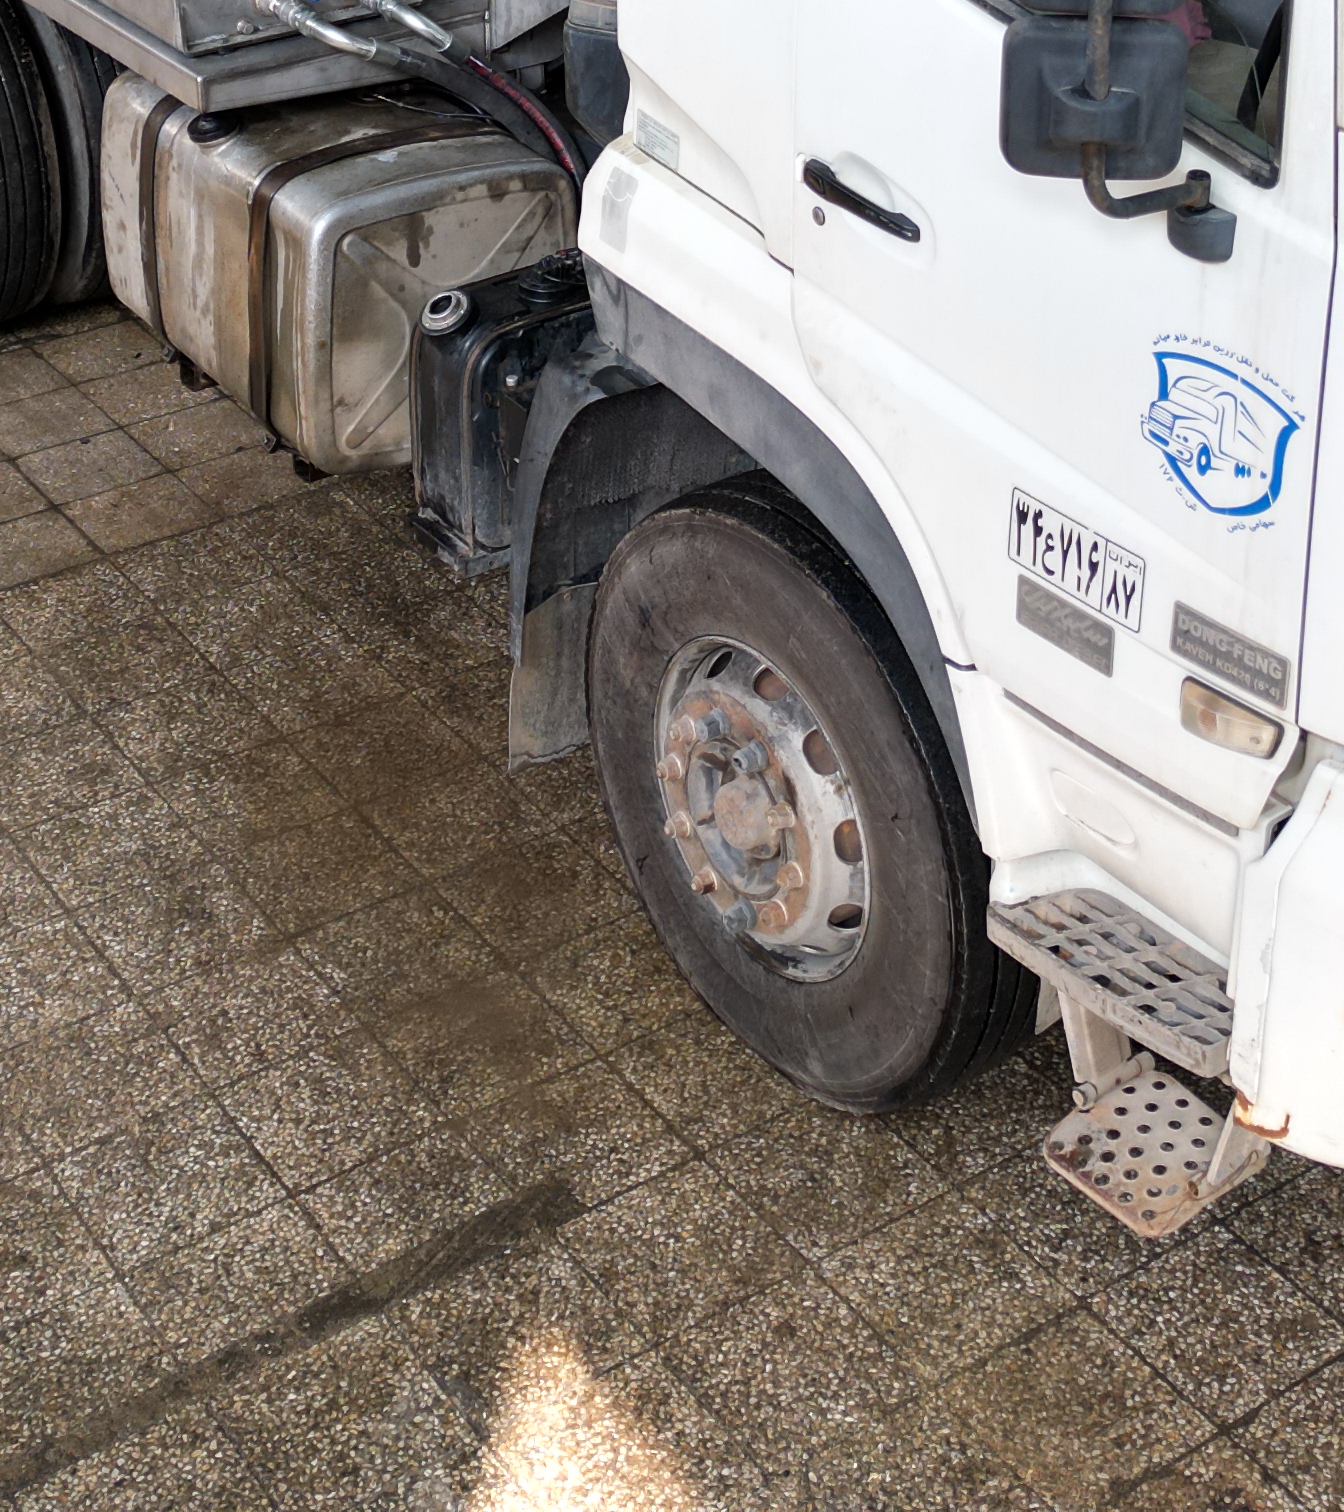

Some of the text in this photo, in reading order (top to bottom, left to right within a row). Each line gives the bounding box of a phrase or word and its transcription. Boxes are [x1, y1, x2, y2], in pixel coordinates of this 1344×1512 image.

[1226, 521, 1247, 534] خاص
[1108, 548, 1143, 576] ایران
[1176, 635, 1214, 665] KAVEH
